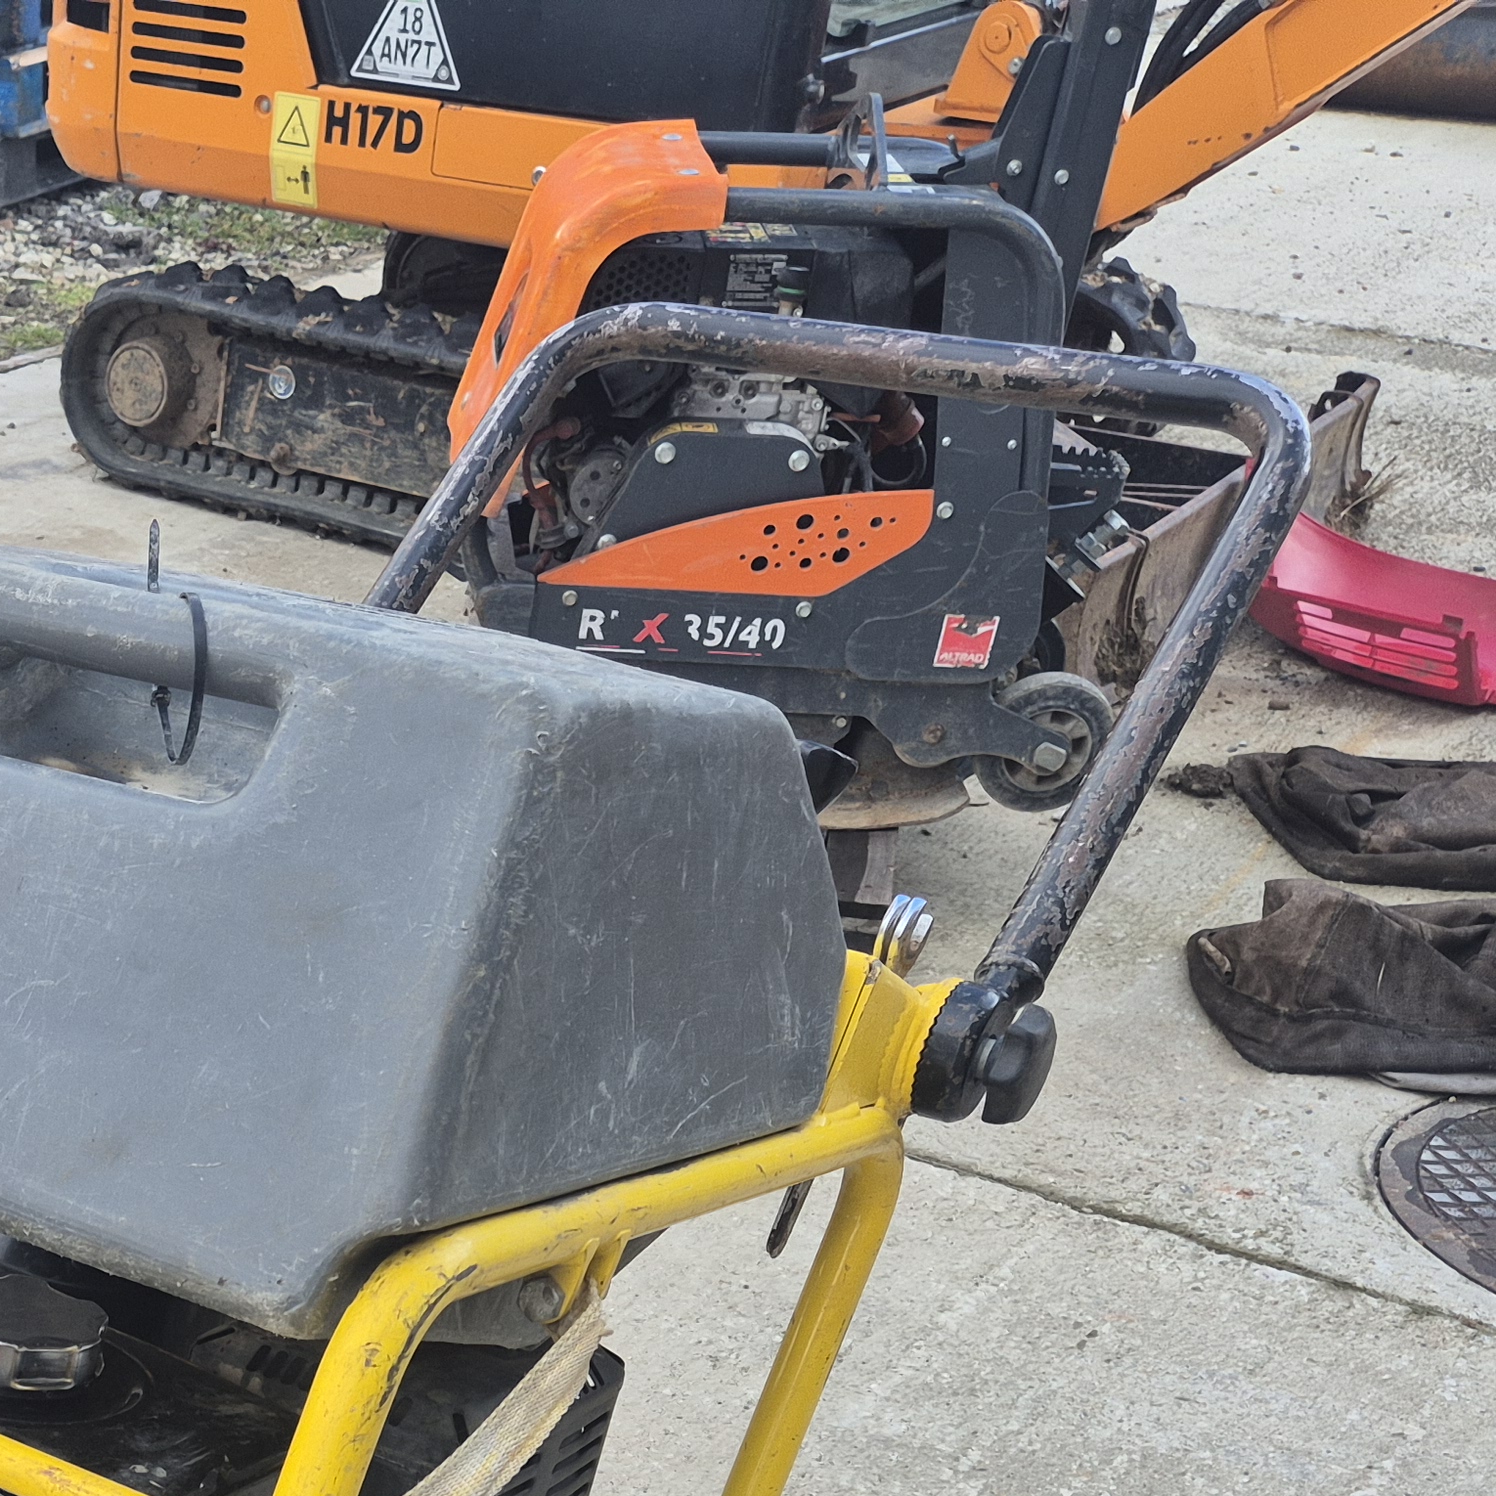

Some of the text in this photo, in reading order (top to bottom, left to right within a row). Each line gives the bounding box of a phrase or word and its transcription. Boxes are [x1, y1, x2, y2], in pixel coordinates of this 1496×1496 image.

[398, 5, 424, 36] 18
[379, 36, 436, 70] AN7T
[324, 99, 424, 154] H17D
[939, 651, 985, 664] ALTRAD
